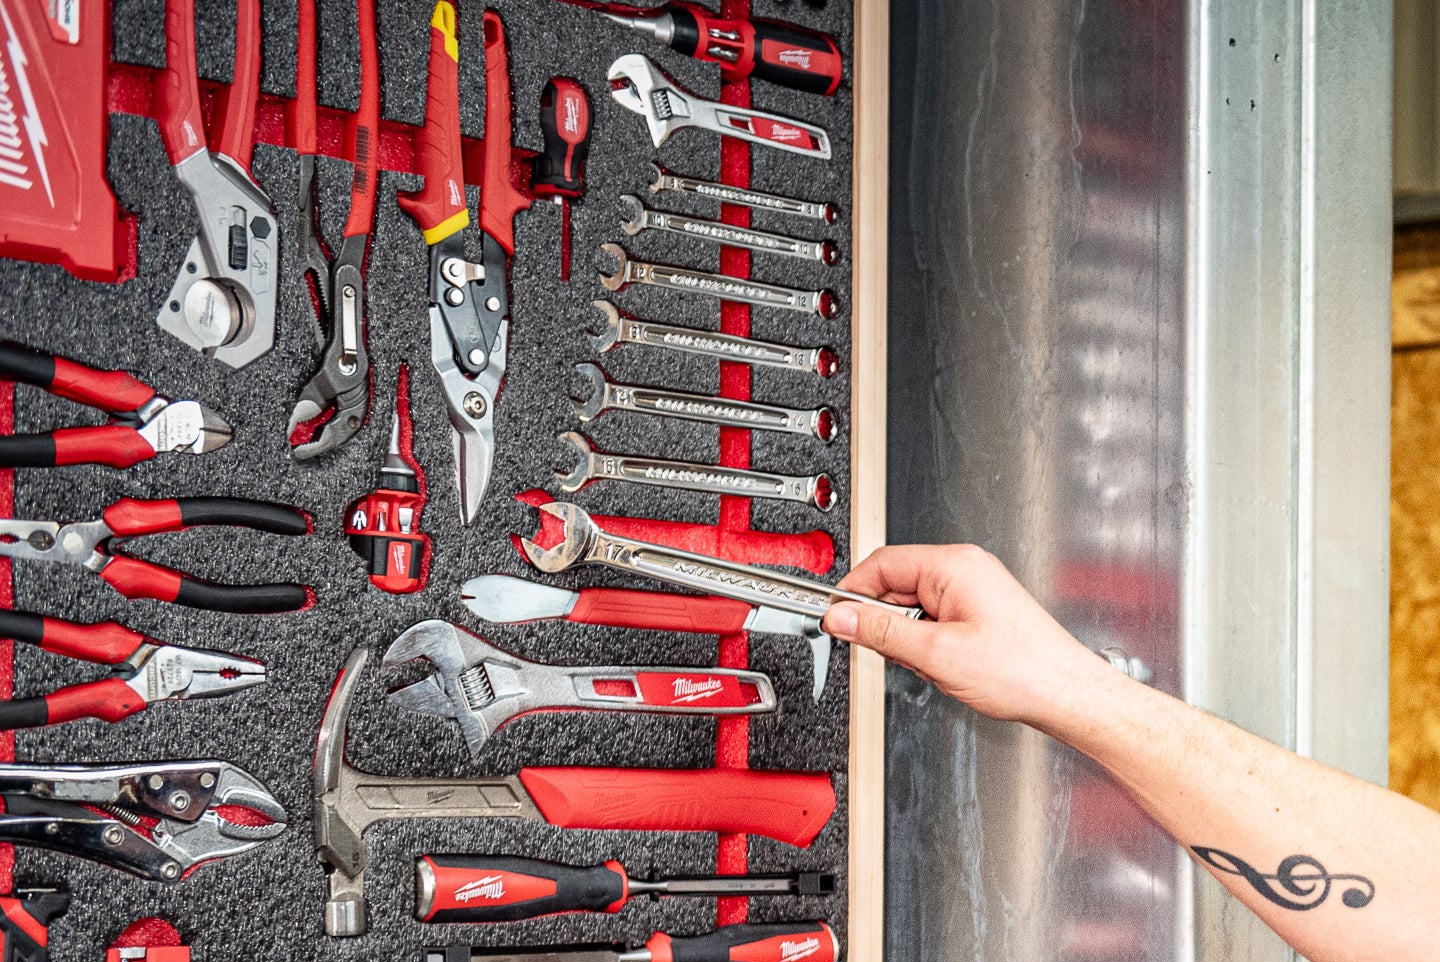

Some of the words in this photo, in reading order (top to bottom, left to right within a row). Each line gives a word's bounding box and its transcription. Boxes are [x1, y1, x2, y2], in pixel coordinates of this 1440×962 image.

[771, 124, 800, 137] Milwaukee
[636, 265, 646, 279] 12
[797, 295, 806, 307] 12
[614, 387, 629, 405] 14
[792, 415, 804, 428] 14
[605, 542, 625, 562] 17
[673, 561, 826, 607] MILWAUKEE
[672, 678, 722, 697] Milwaukee
[455, 880, 506, 903] Milwaukee
[780, 937, 819, 959] Milwaukee
